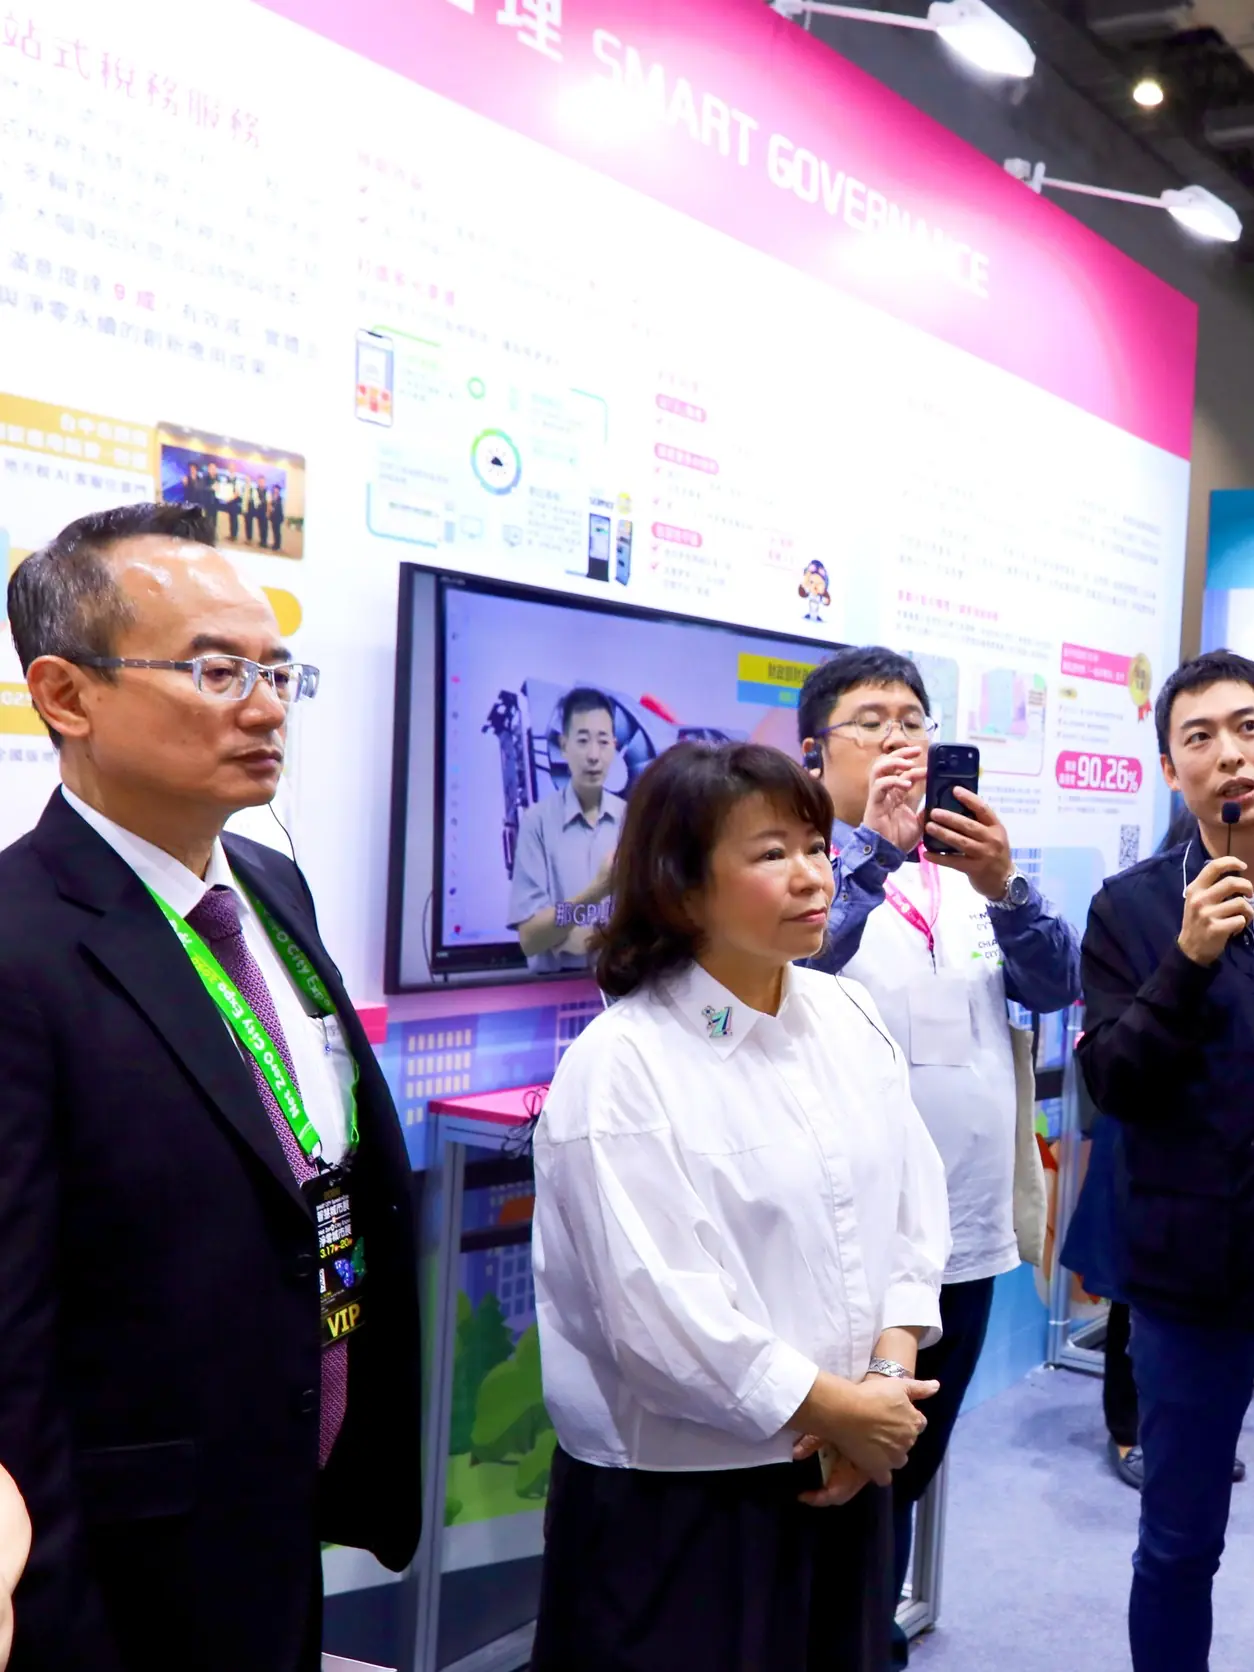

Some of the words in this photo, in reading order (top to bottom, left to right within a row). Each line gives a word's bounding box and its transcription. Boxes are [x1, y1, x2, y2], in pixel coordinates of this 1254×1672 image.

[767, 133, 991, 299] GOVERNANCE
[1077, 755, 1139, 793] 90.26%
[217, 981, 245, 1018] Expo
[242, 1016, 266, 1052] City
[283, 1088, 301, 1119] Net
[326, 1302, 361, 1339] VIP
